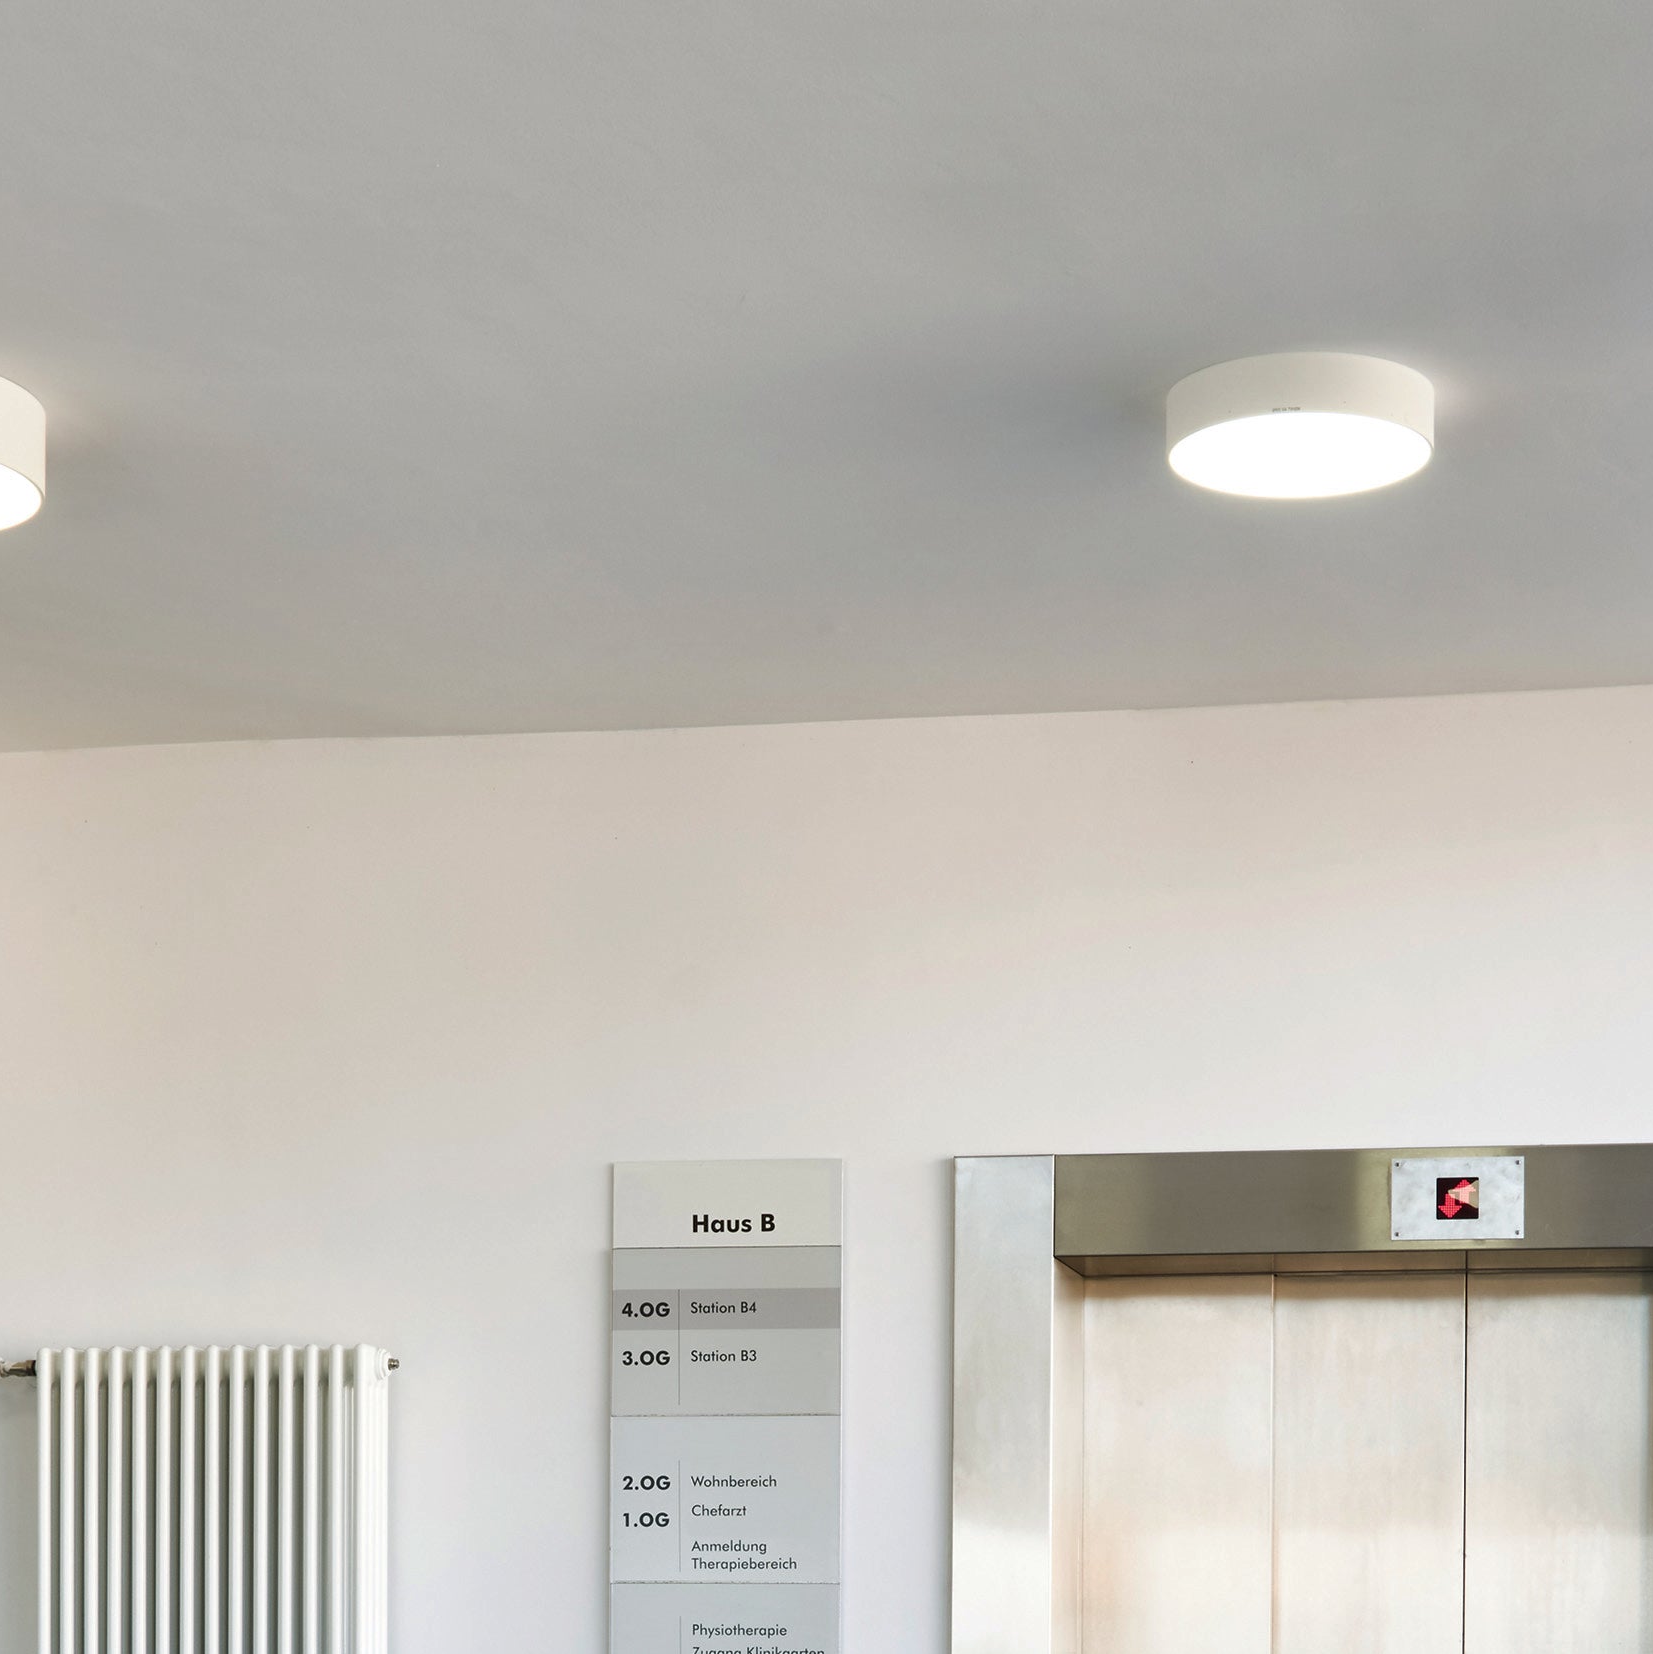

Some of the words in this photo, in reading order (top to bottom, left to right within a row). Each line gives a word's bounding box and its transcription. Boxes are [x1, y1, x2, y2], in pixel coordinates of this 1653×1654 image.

[692, 1213, 753, 1234] Haus
[760, 1213, 776, 1233] B
[621, 1301, 671, 1318] 4.OG
[690, 1300, 736, 1315] Station
[740, 1300, 757, 1314] B4
[621, 1349, 671, 1367] 3.OG
[690, 1349, 736, 1363] Station
[740, 1349, 757, 1363] B3
[622, 1474, 671, 1491] 2.OG
[690, 1474, 777, 1488] Wohnbereich
[691, 1503, 747, 1517] Chefarzt
[622, 1511, 670, 1528] 1.OG
[691, 1539, 767, 1555] Anmeldung
[690, 1557, 798, 1572] Therapiebereich
[692, 1623, 788, 1639] Physiotherapie
